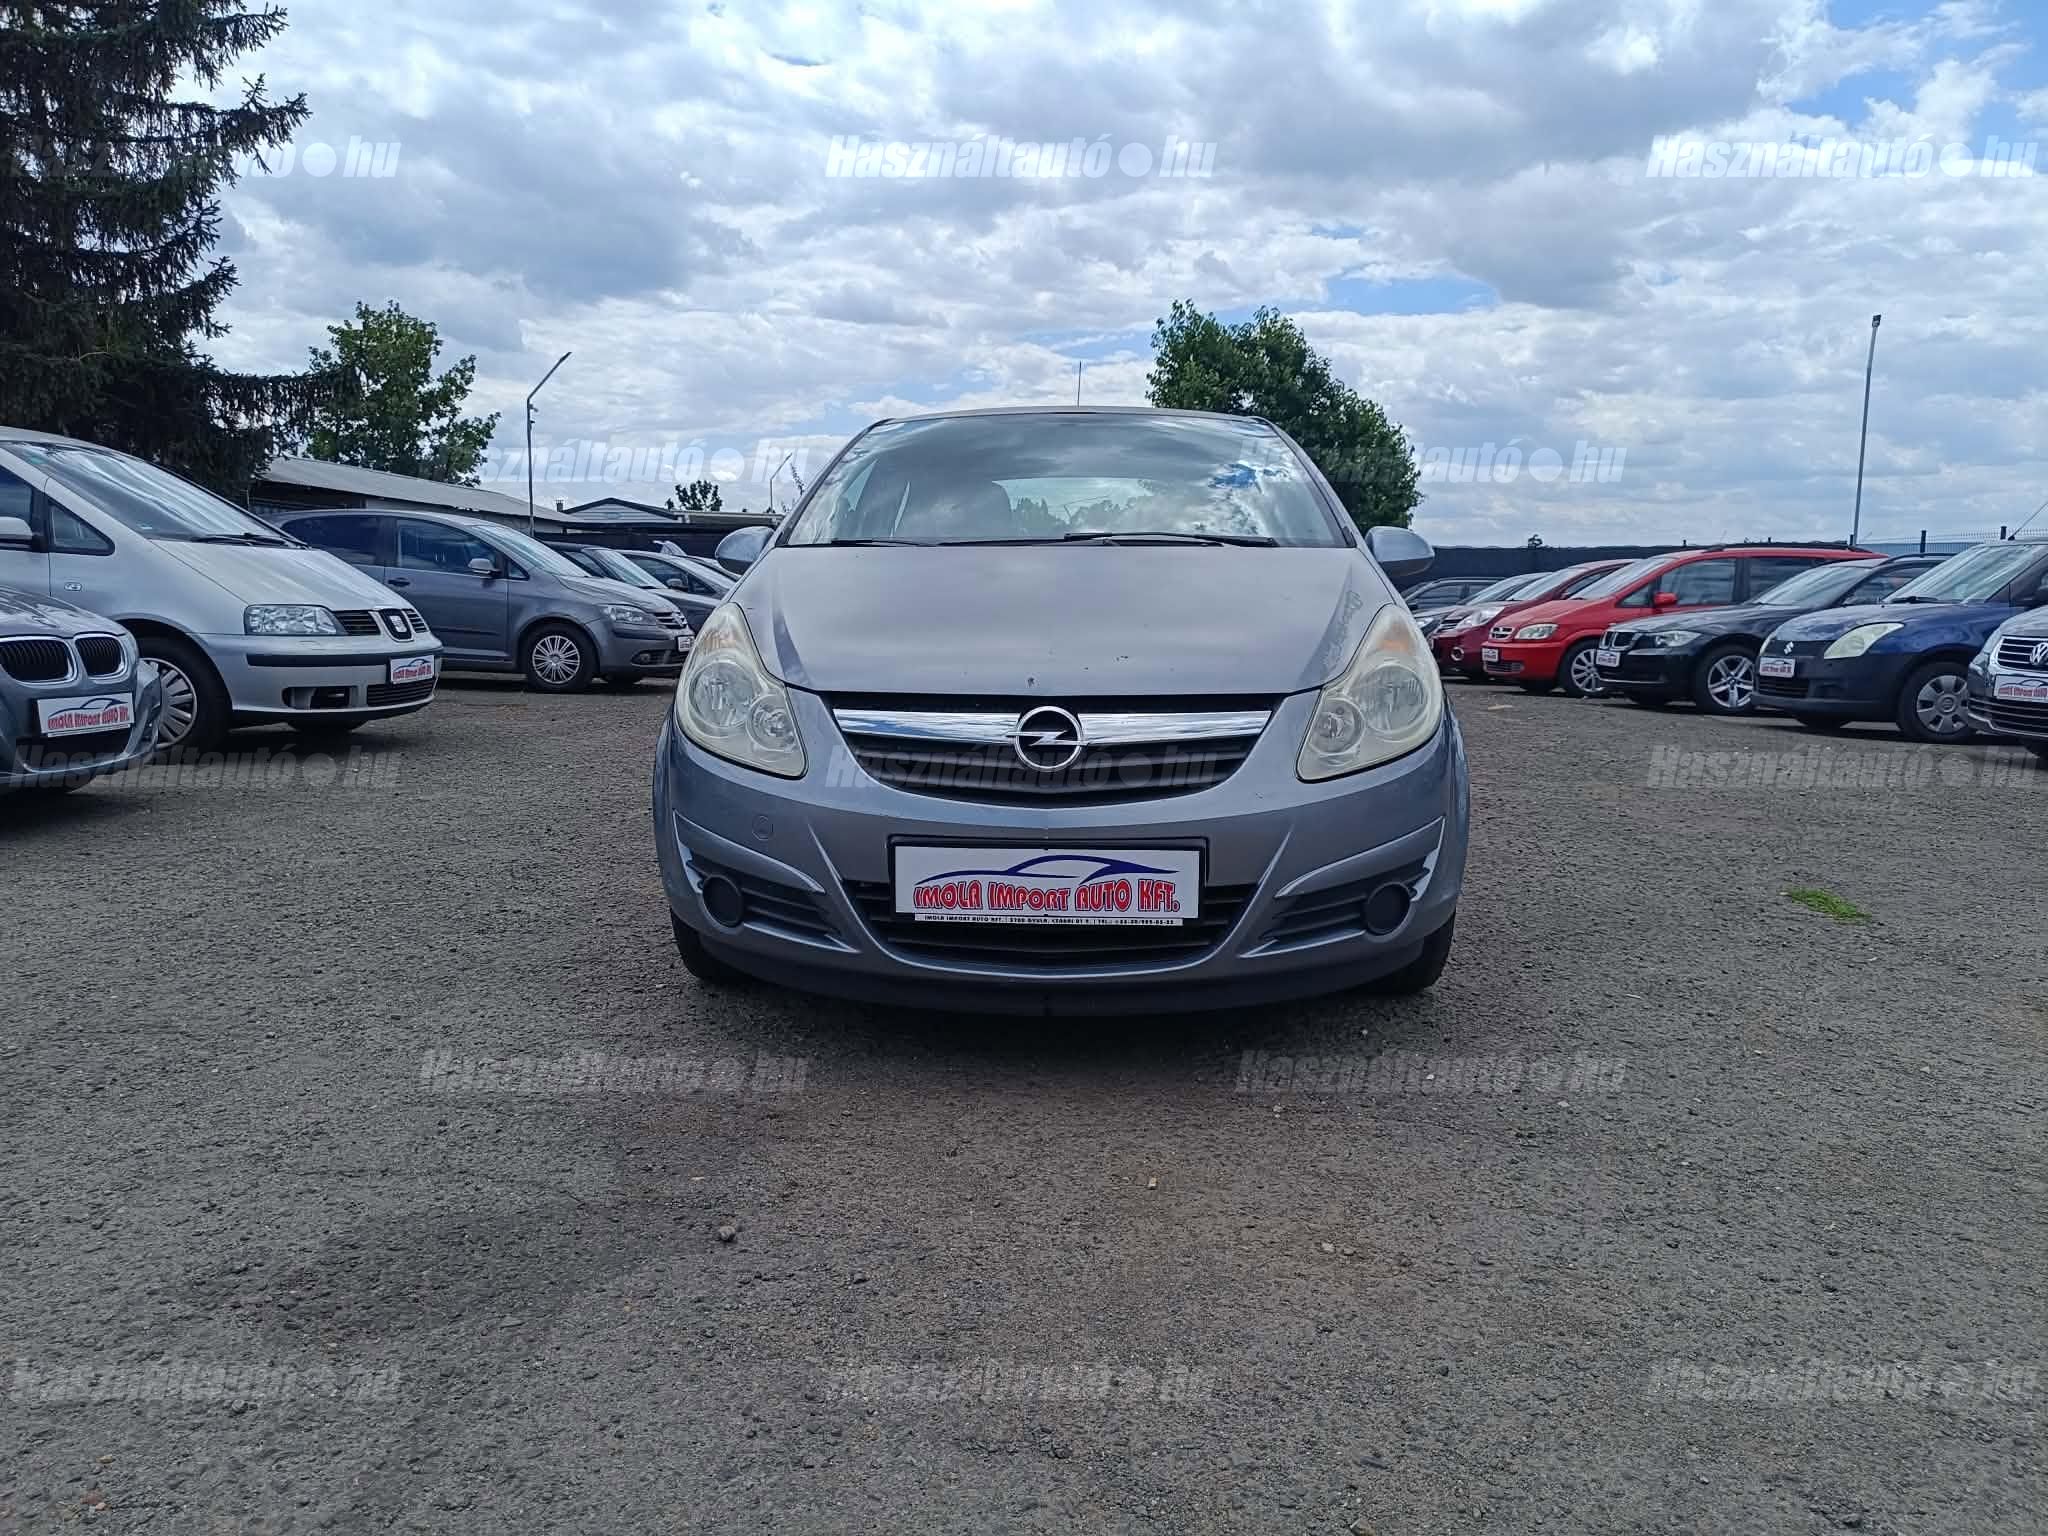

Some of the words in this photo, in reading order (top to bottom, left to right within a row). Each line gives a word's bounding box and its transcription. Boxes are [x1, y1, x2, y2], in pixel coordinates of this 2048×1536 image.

[914, 880, 983, 910] IMOLA
[987, 882, 1071, 911] IMPORT
[1075, 879, 1133, 912] AUTO
[1138, 879, 1181, 912] KFT.
